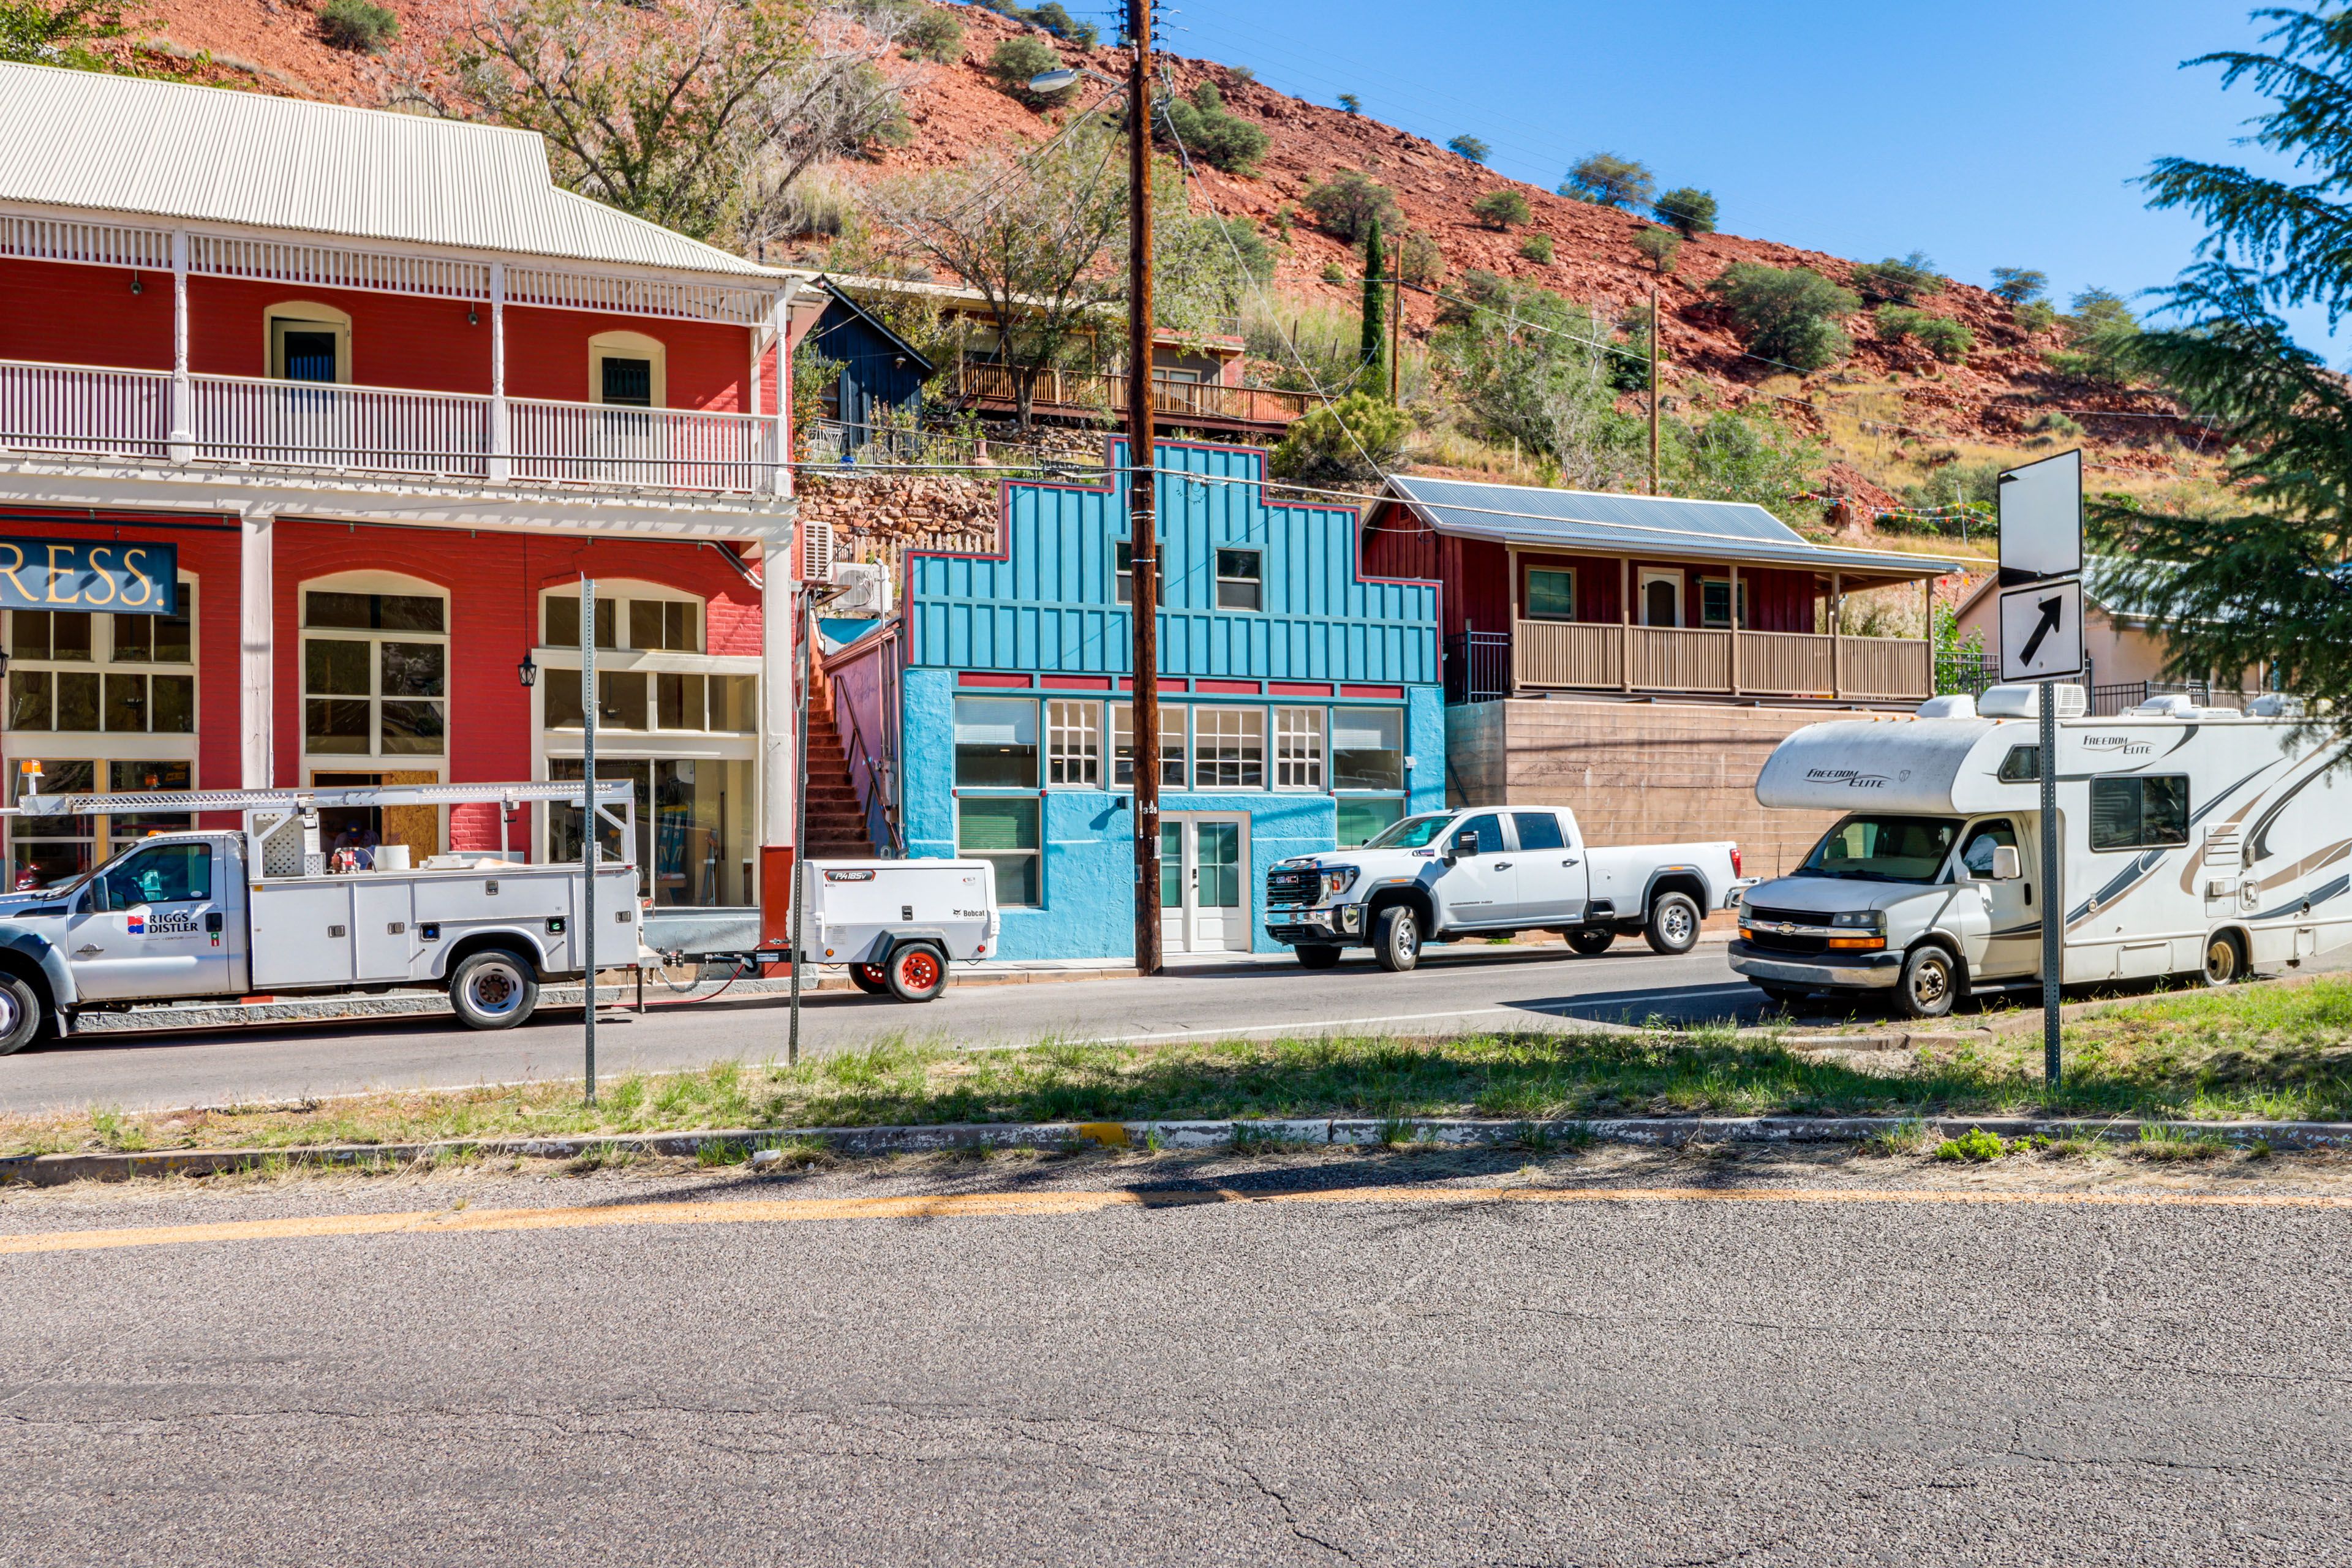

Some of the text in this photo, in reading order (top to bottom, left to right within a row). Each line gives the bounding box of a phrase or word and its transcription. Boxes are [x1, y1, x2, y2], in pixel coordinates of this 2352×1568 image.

[2083, 735, 2128, 745] FREEDOM
[2123, 745, 2152, 755] ELITE
[1807, 768, 1859, 778] FREEDOM
[1849, 778, 1887, 788] ELITE
[149, 913, 189, 923] RIGGS
[149, 922, 198, 933] DISTLER
